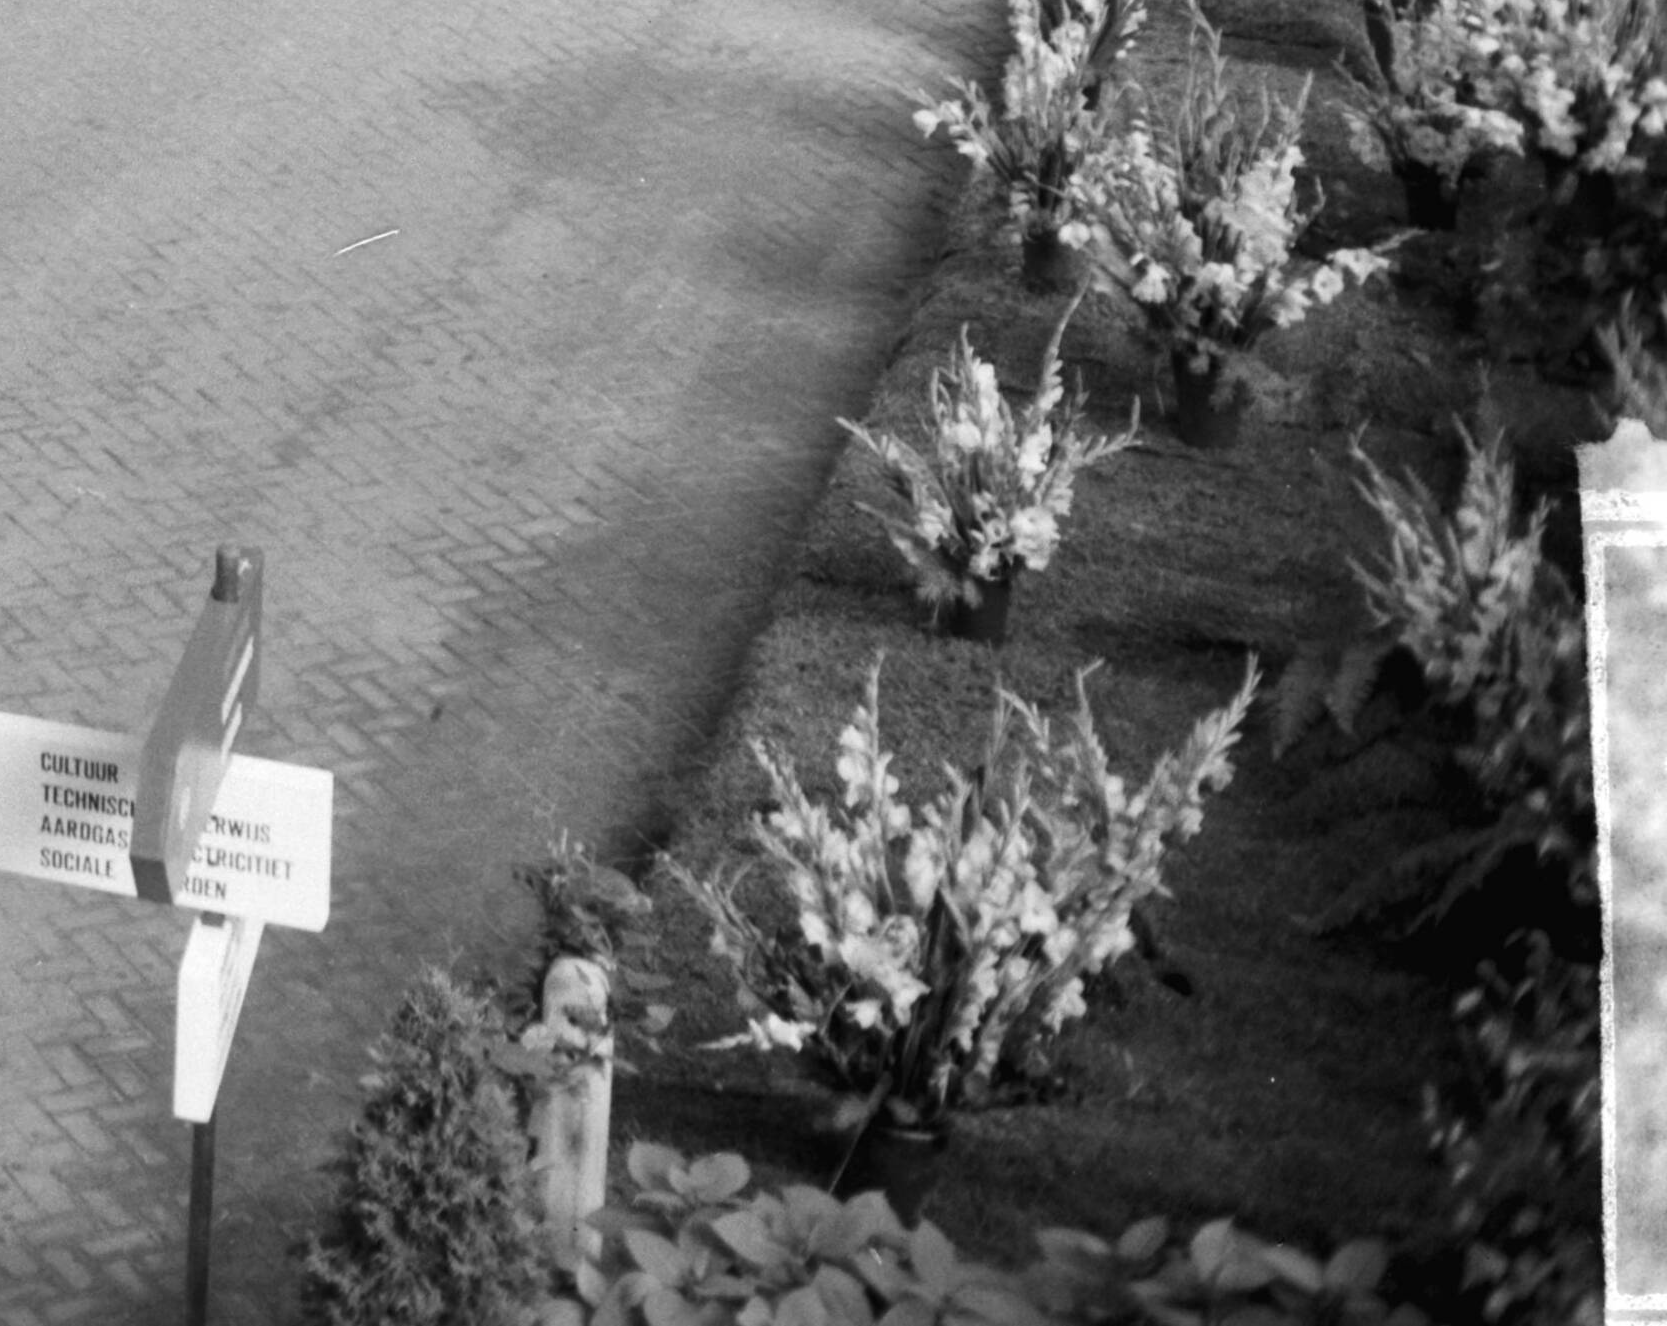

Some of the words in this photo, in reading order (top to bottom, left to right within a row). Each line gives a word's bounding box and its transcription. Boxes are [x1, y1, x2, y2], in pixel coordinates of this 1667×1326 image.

[40, 751, 119, 784] CULTUUR
[39, 814, 130, 850] AARDGAS
[39, 847, 116, 879] SOCIALE
